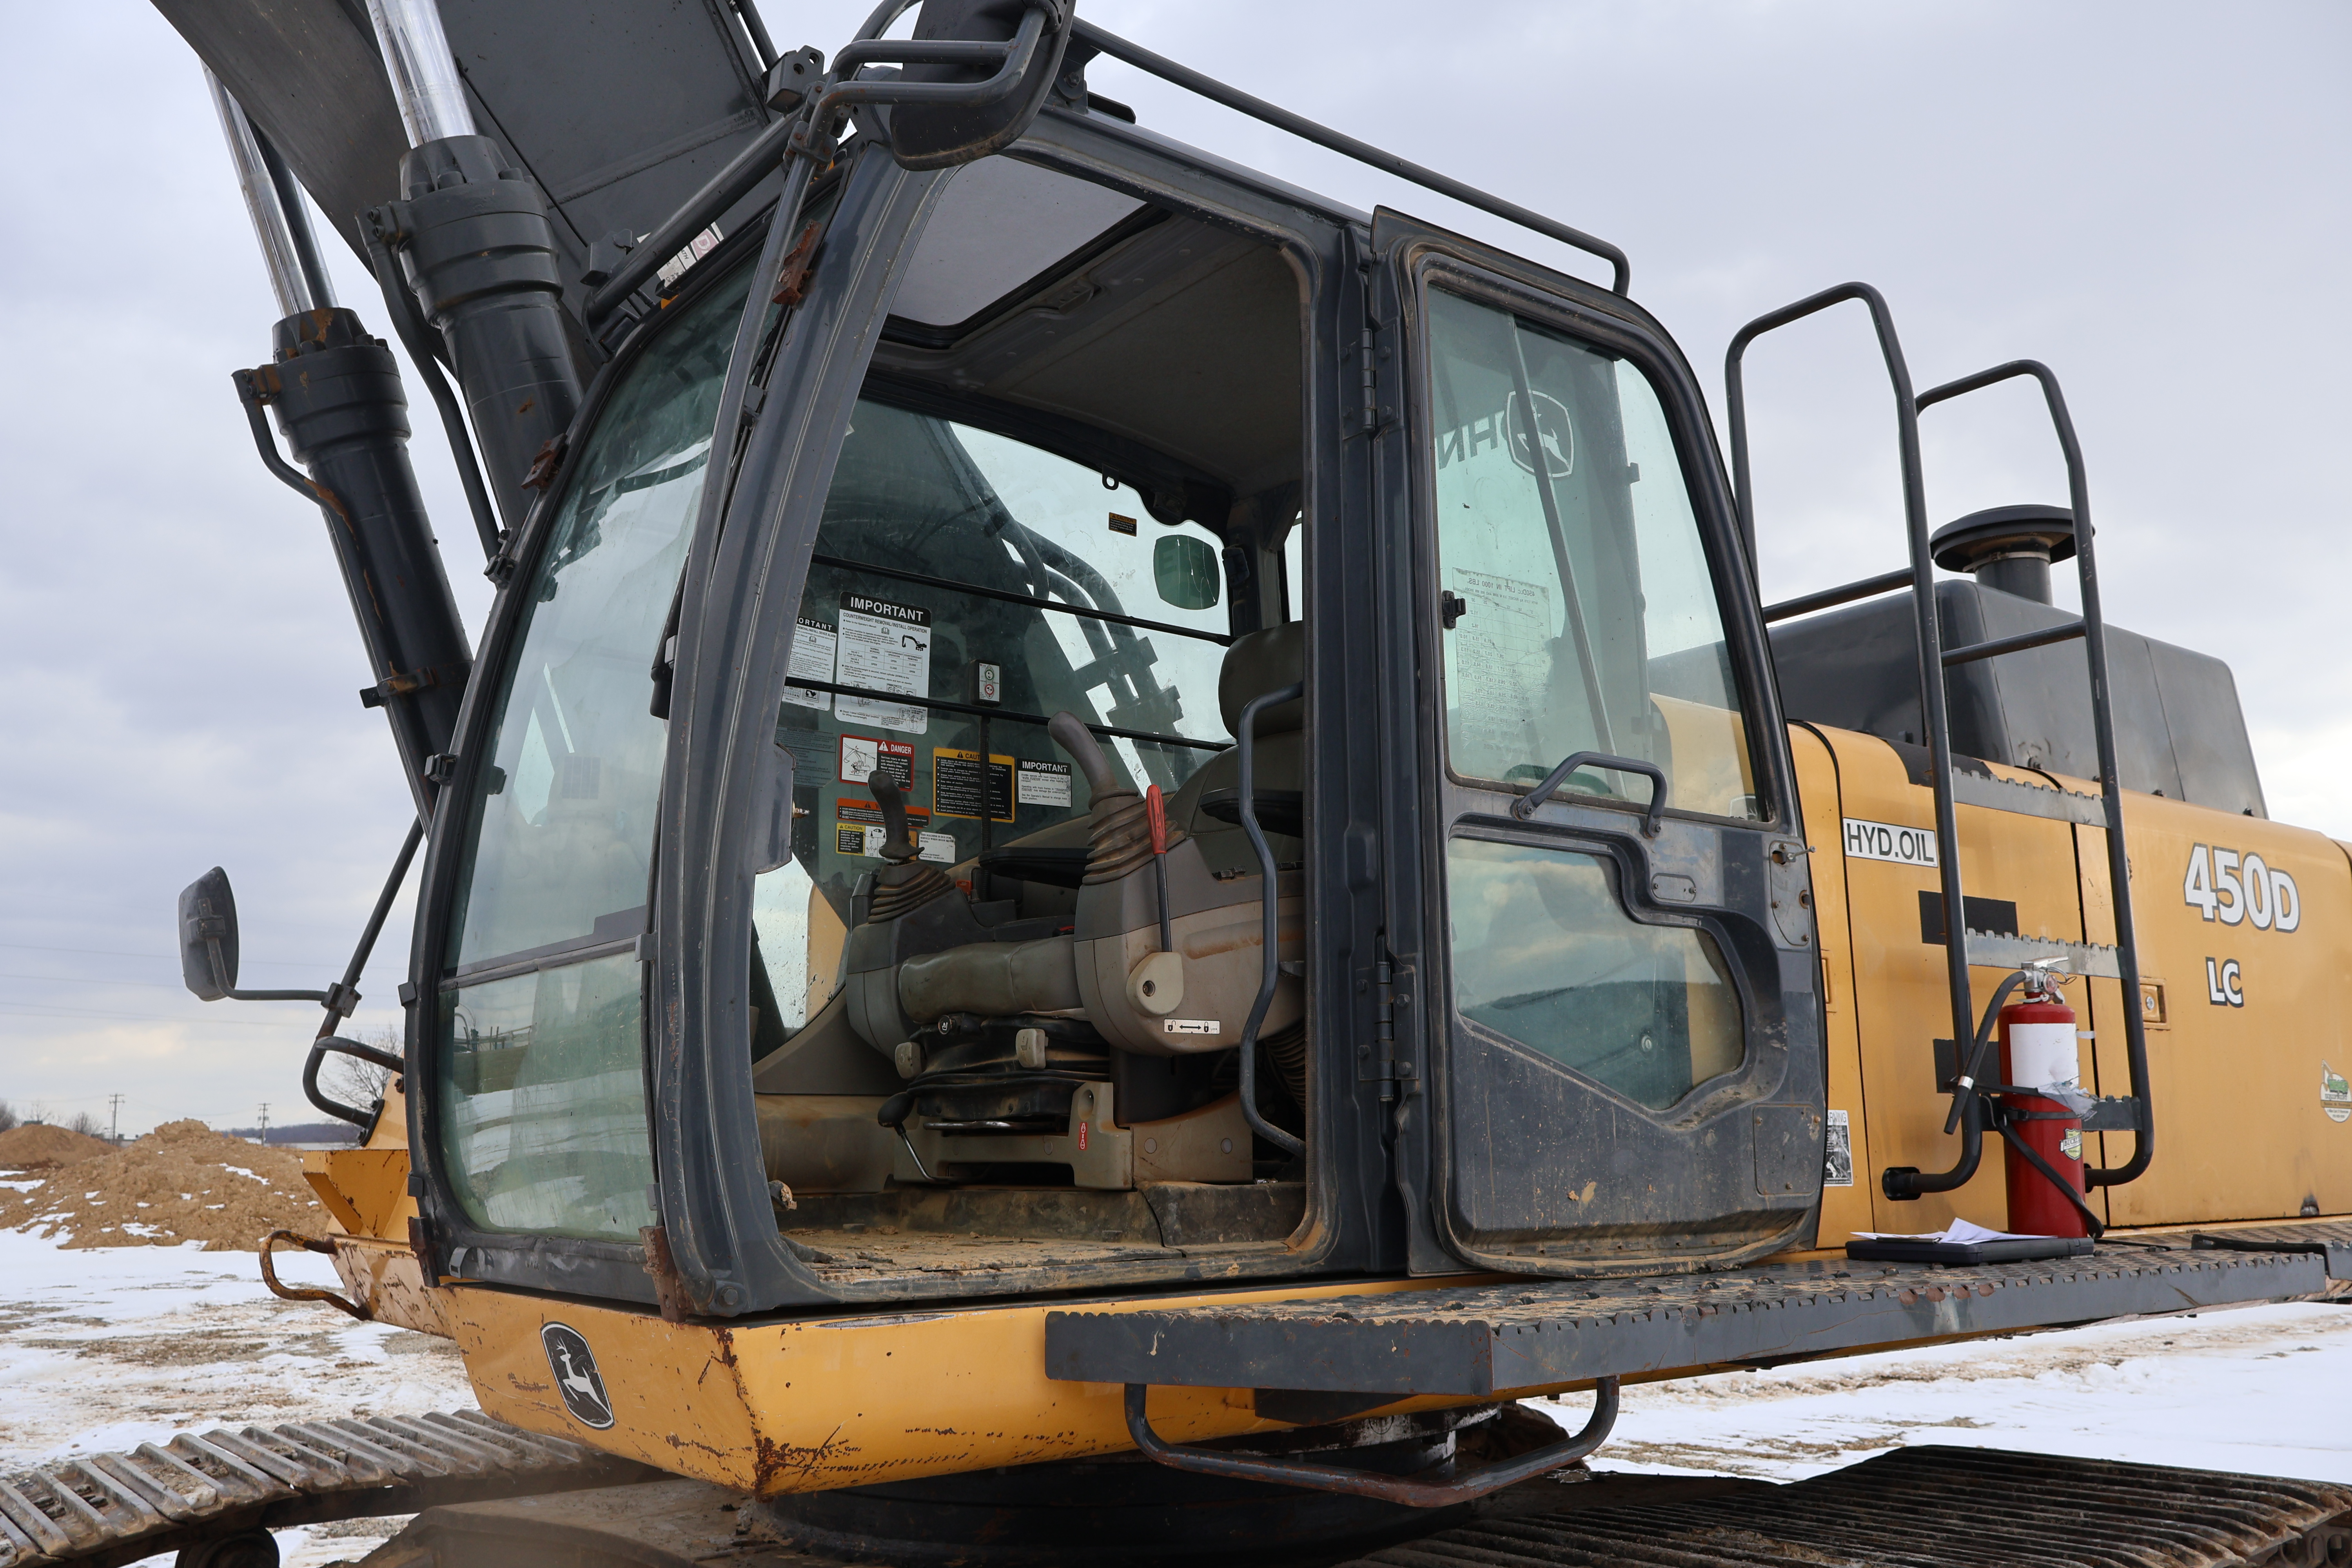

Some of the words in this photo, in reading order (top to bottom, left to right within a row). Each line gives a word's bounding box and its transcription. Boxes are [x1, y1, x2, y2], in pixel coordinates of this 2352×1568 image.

[850, 597, 924, 621] IMPORTANT
[799, 617, 833, 631] ORTANT
[843, 612, 874, 622] COUNTERWEIGHT
[875, 619, 906, 629] REMOVAL/INSTALL
[891, 744, 911, 754] DANGER
[1022, 761, 1067, 773] IMPORTANT
[1847, 823, 1934, 862] HYD.OIL
[2184, 842, 2300, 933] 450D
[2205, 956, 2244, 1008] LC
[1829, 1112, 1846, 1123] RNING
